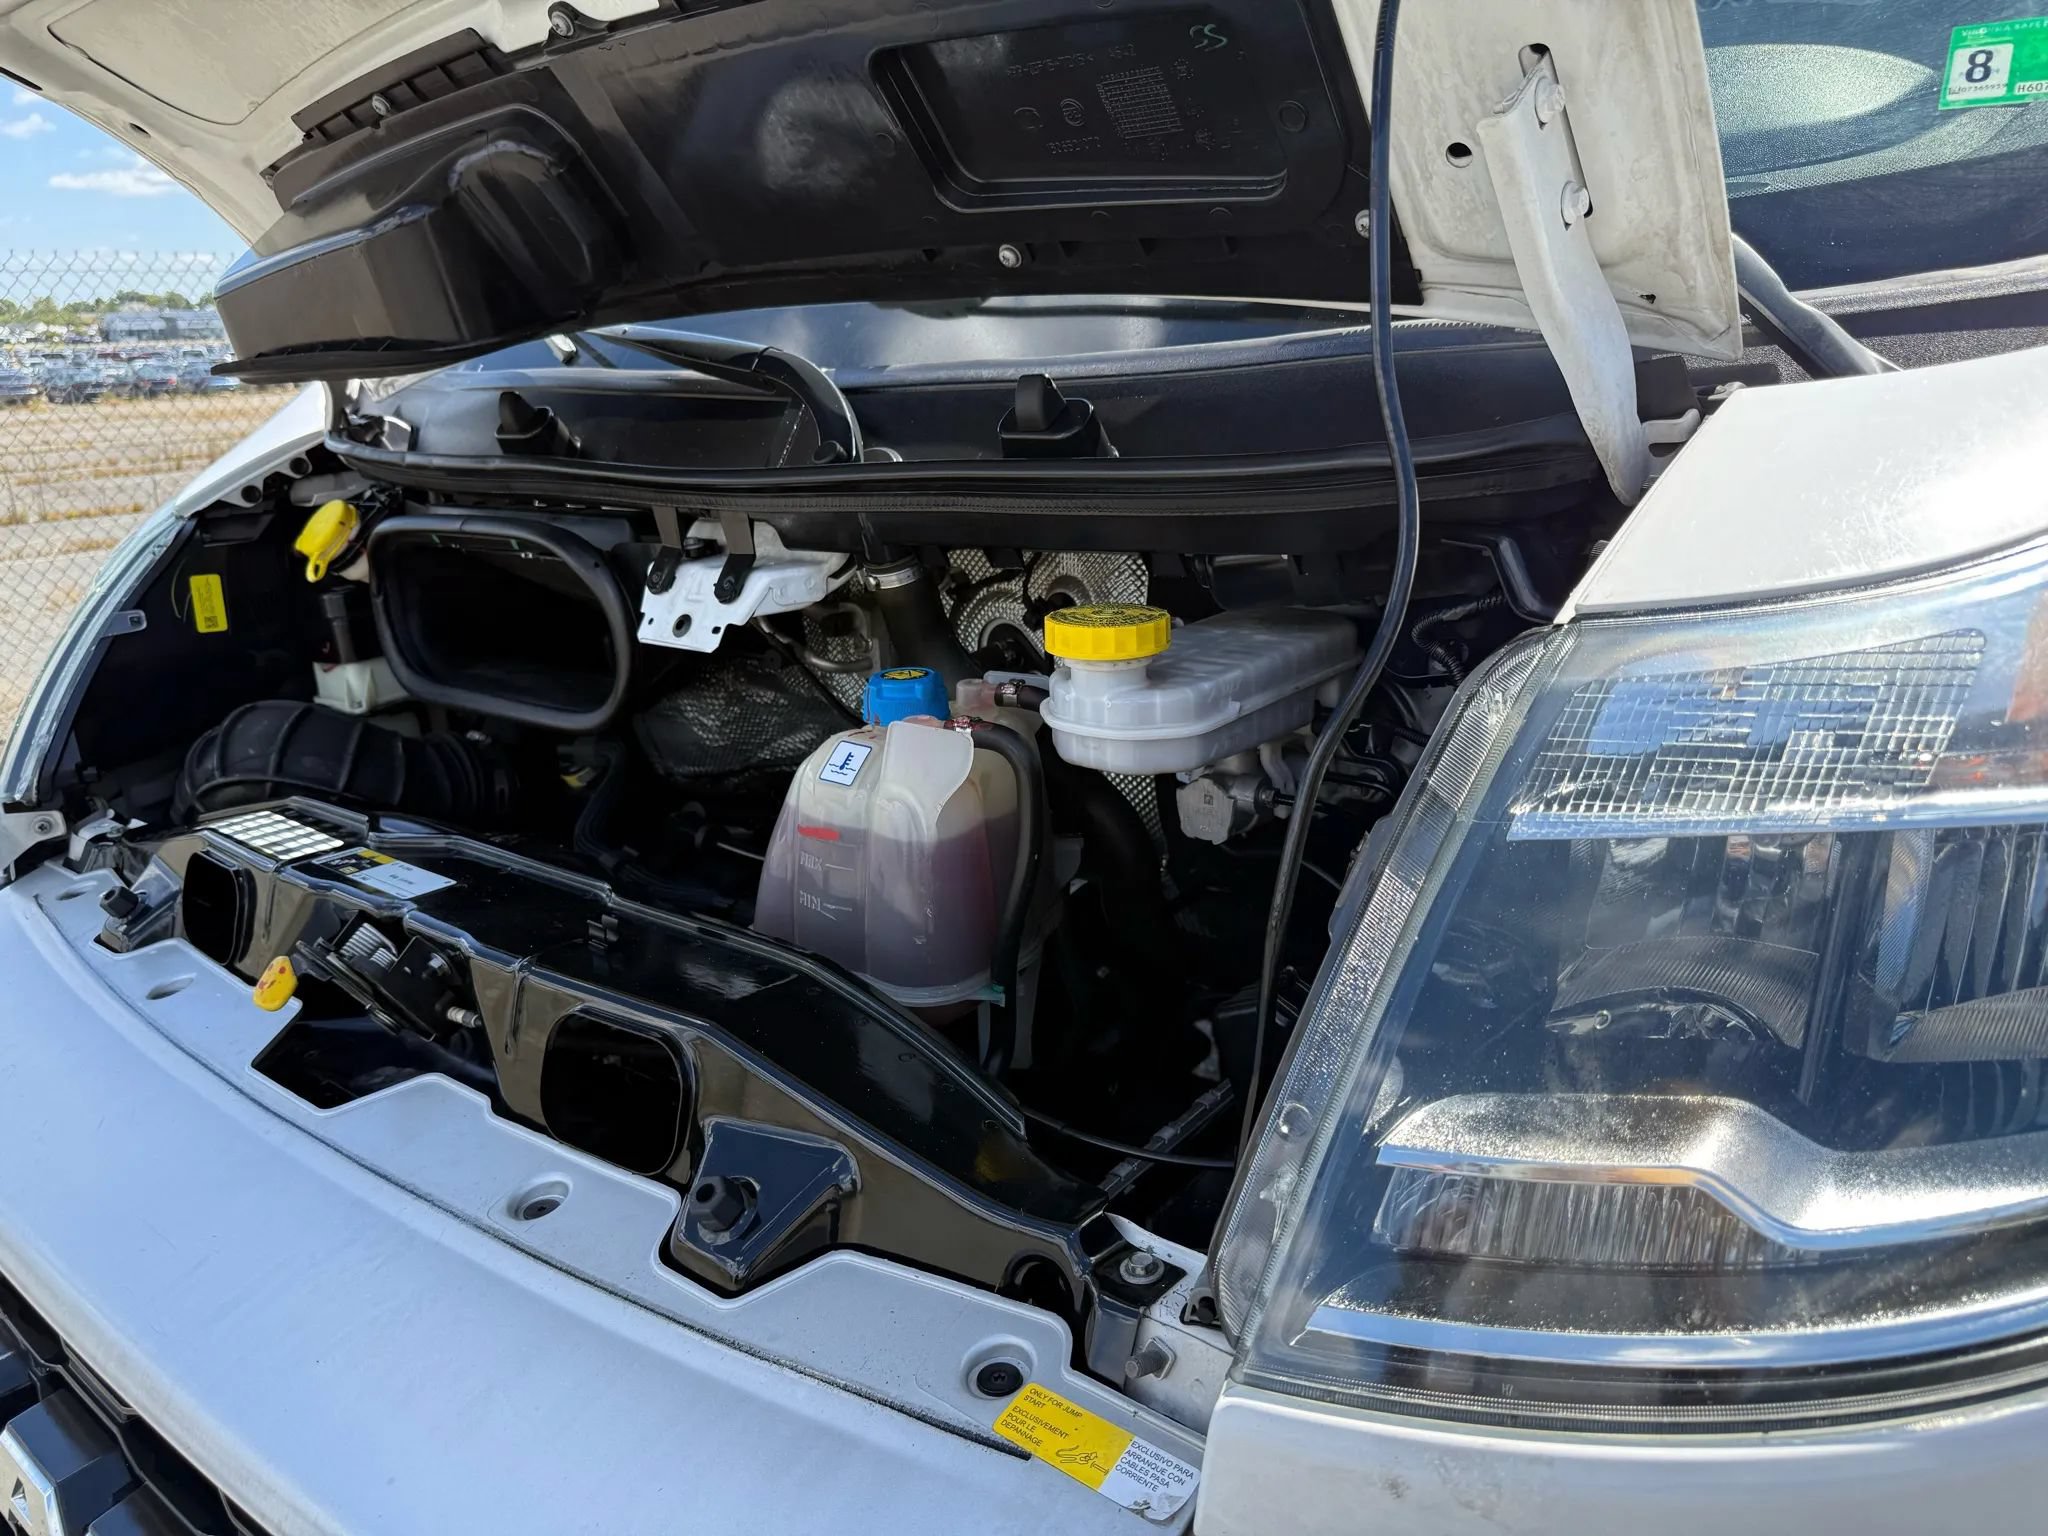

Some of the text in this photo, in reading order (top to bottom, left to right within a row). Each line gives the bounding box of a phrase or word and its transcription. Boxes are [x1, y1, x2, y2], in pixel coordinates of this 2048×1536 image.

[1965, 49, 1994, 83] 8
[1023, 1395, 1046, 1409] START
[1029, 1388, 1083, 1418] ONLY FOR JUMP
[1000, 1419, 1043, 1447] DEPANNAGE
[1006, 1413, 1037, 1433] POUR LE
[1012, 1405, 1069, 1440] EXCLUSIVEMENT
[1120, 1456, 1170, 1489] CABLES PASA
[1124, 1449, 1186, 1486] ARRANQUE CON
[1130, 1441, 1194, 1480] EXCLUSIVO PARA
[1115, 1464, 1159, 1493] CORRIENTE
